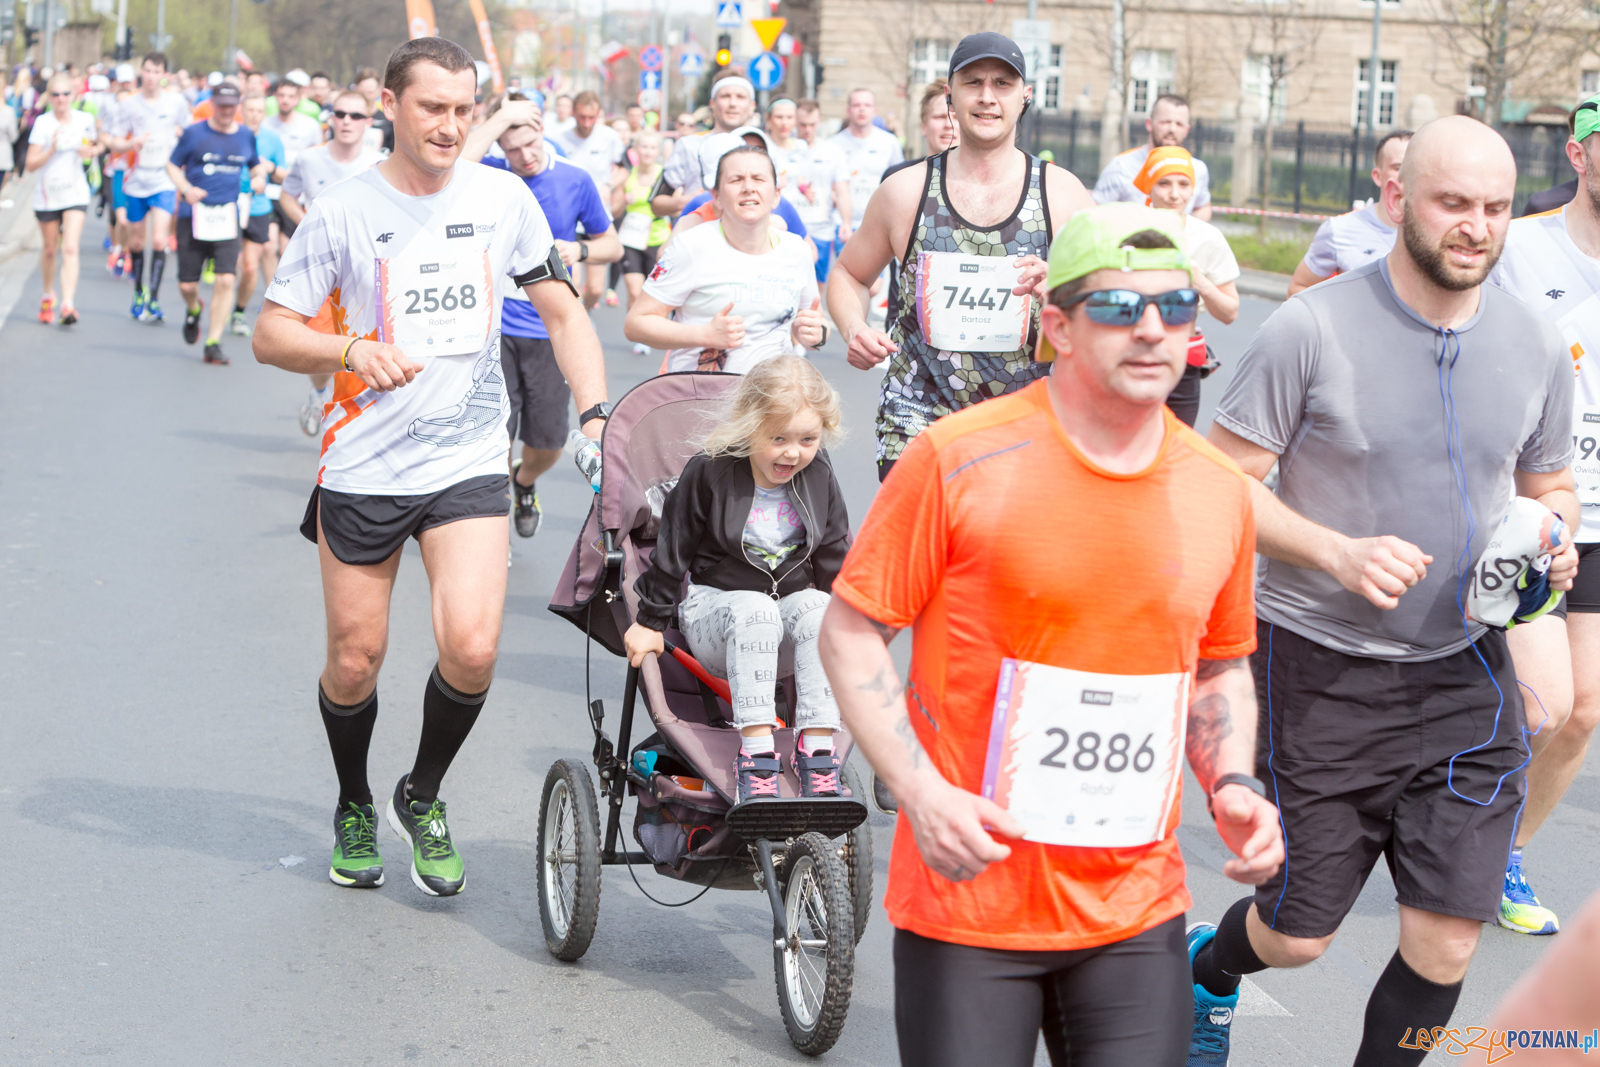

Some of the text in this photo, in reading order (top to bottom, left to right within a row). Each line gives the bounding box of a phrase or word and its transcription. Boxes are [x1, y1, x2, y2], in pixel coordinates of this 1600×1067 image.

[376, 232, 395, 243] 4F
[404, 284, 477, 315] 2568
[943, 286, 1012, 311] 7447
[1545, 288, 1565, 300] 4F
[428, 317, 456, 326] Robert
[961, 316, 991, 324] Bartosz
[1473, 552, 1531, 599] 091
[740, 641, 777, 653] BELLE
[738, 695, 773, 707] BELLE
[1039, 727, 1155, 773] 2886
